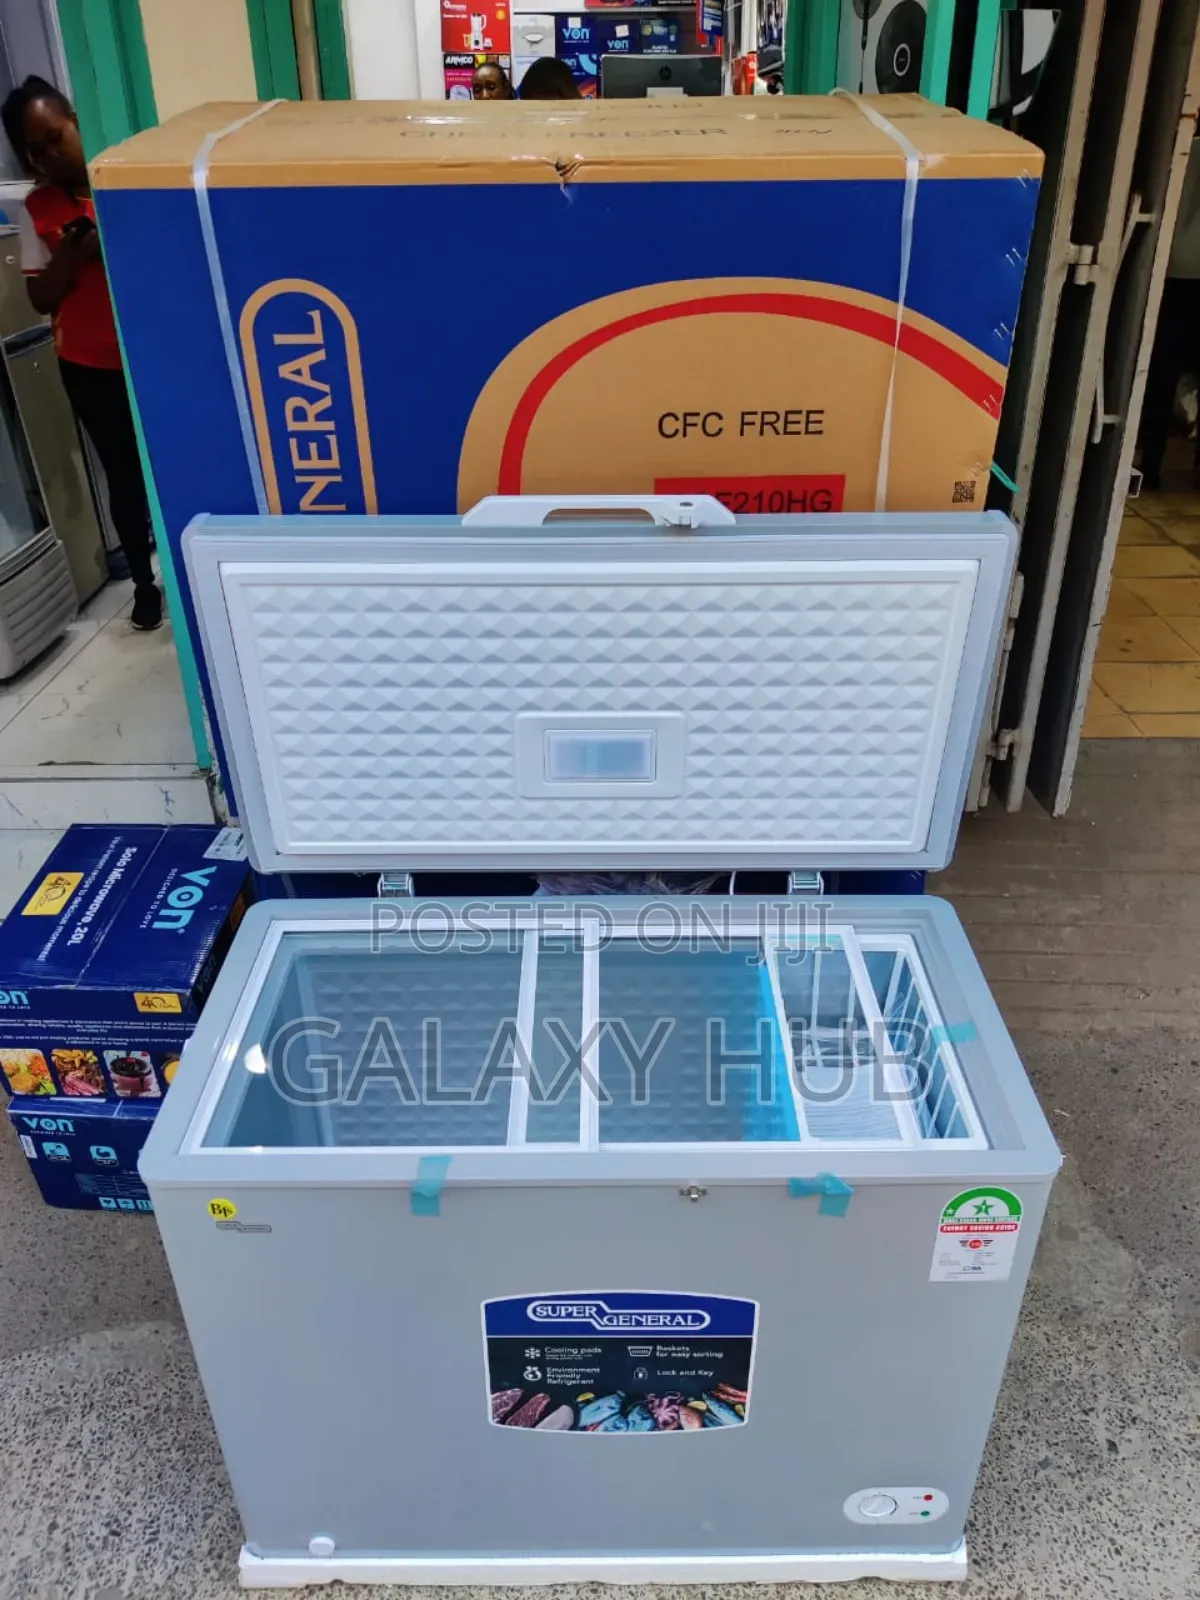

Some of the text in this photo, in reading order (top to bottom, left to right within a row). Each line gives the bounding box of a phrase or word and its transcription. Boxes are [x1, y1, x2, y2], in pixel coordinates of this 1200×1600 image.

[562, 28, 590, 40] von
[607, 40, 629, 49] von
[273, 310, 346, 511] NERAL
[658, 409, 825, 438] CFC FREE
[66, 846, 138, 946] Solo Microwave, 20L
[151, 866, 217, 930] von
[0, 990, 29, 1005] on
[21, 1117, 74, 1132] von
[535, 1305, 700, 1326] SUPER GENERAL
[545, 1346, 578, 1354] Cooling
[693, 1351, 723, 1359] sorting
[698, 1370, 715, 1378] Key
